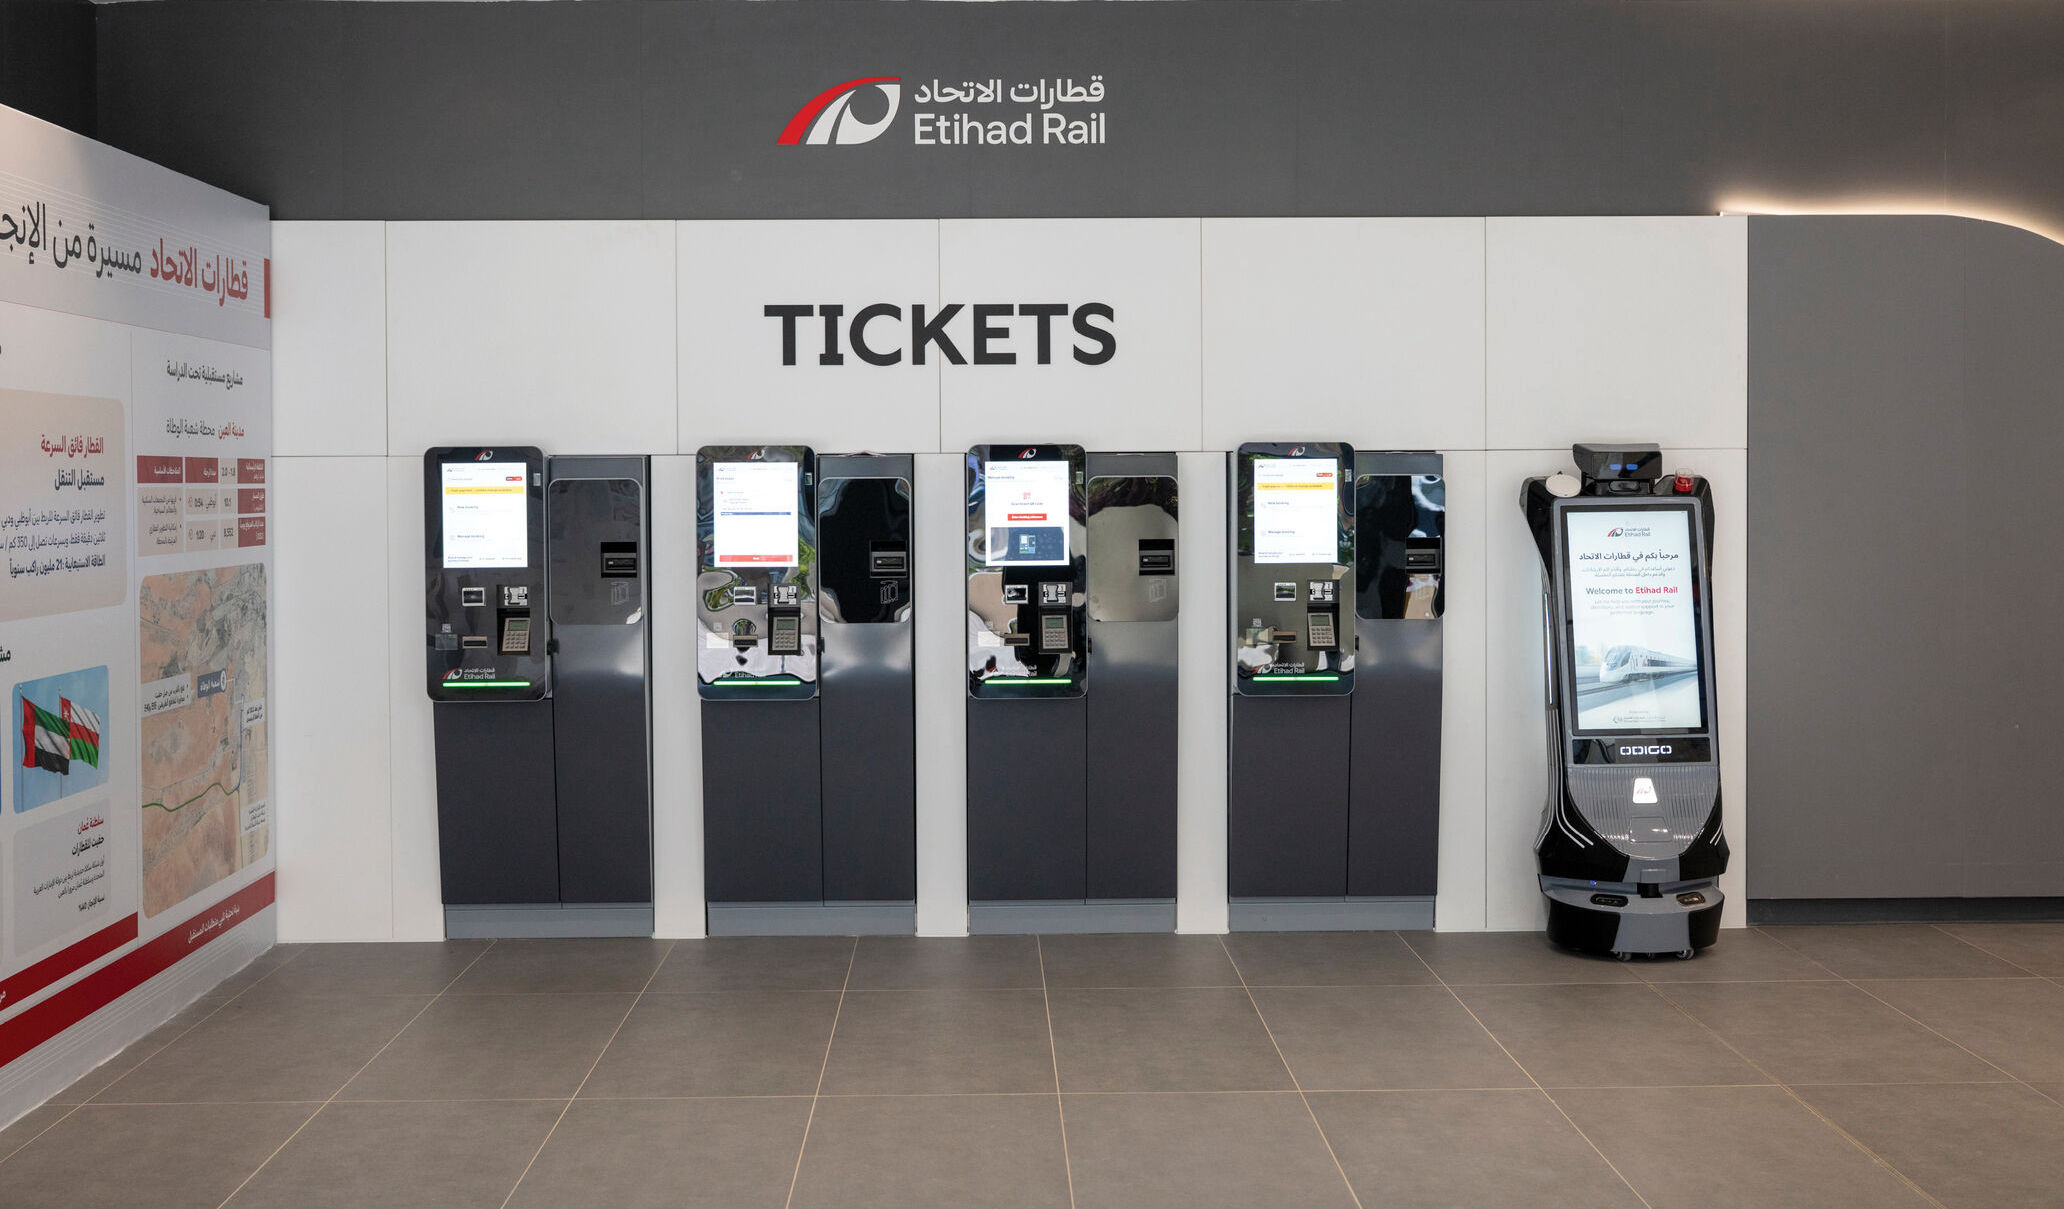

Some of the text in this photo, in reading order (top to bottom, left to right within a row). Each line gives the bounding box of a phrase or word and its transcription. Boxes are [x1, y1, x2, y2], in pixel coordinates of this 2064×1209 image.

[914, 75, 1105, 110] قطارات الاتحاد
[914, 112, 1106, 145] Etihad Rail
[53, 219, 82, 269] من
[88, 223, 142, 279] مسيرة
[150, 237, 198, 288] الاتحاد
[201, 254, 249, 307] قطارات
[763, 302, 1117, 367] TICKETS
[166, 360, 243, 390] مشاريع مستقبلية تحت الدراسة
[41, 434, 104, 458] القطار فائق السرعة
[54, 468, 105, 491] مستقبل التنقل
[17, 536, 28, 549] 350
[1659, 549, 1679, 560] مرحباً
[1603, 552, 1631, 561] قطارات
[1632, 552, 1644, 562] في
[1645, 552, 1658, 562] بكم
[1586, 587, 1623, 595] Welcome
[1620, 745, 1672, 755] ODIGO
